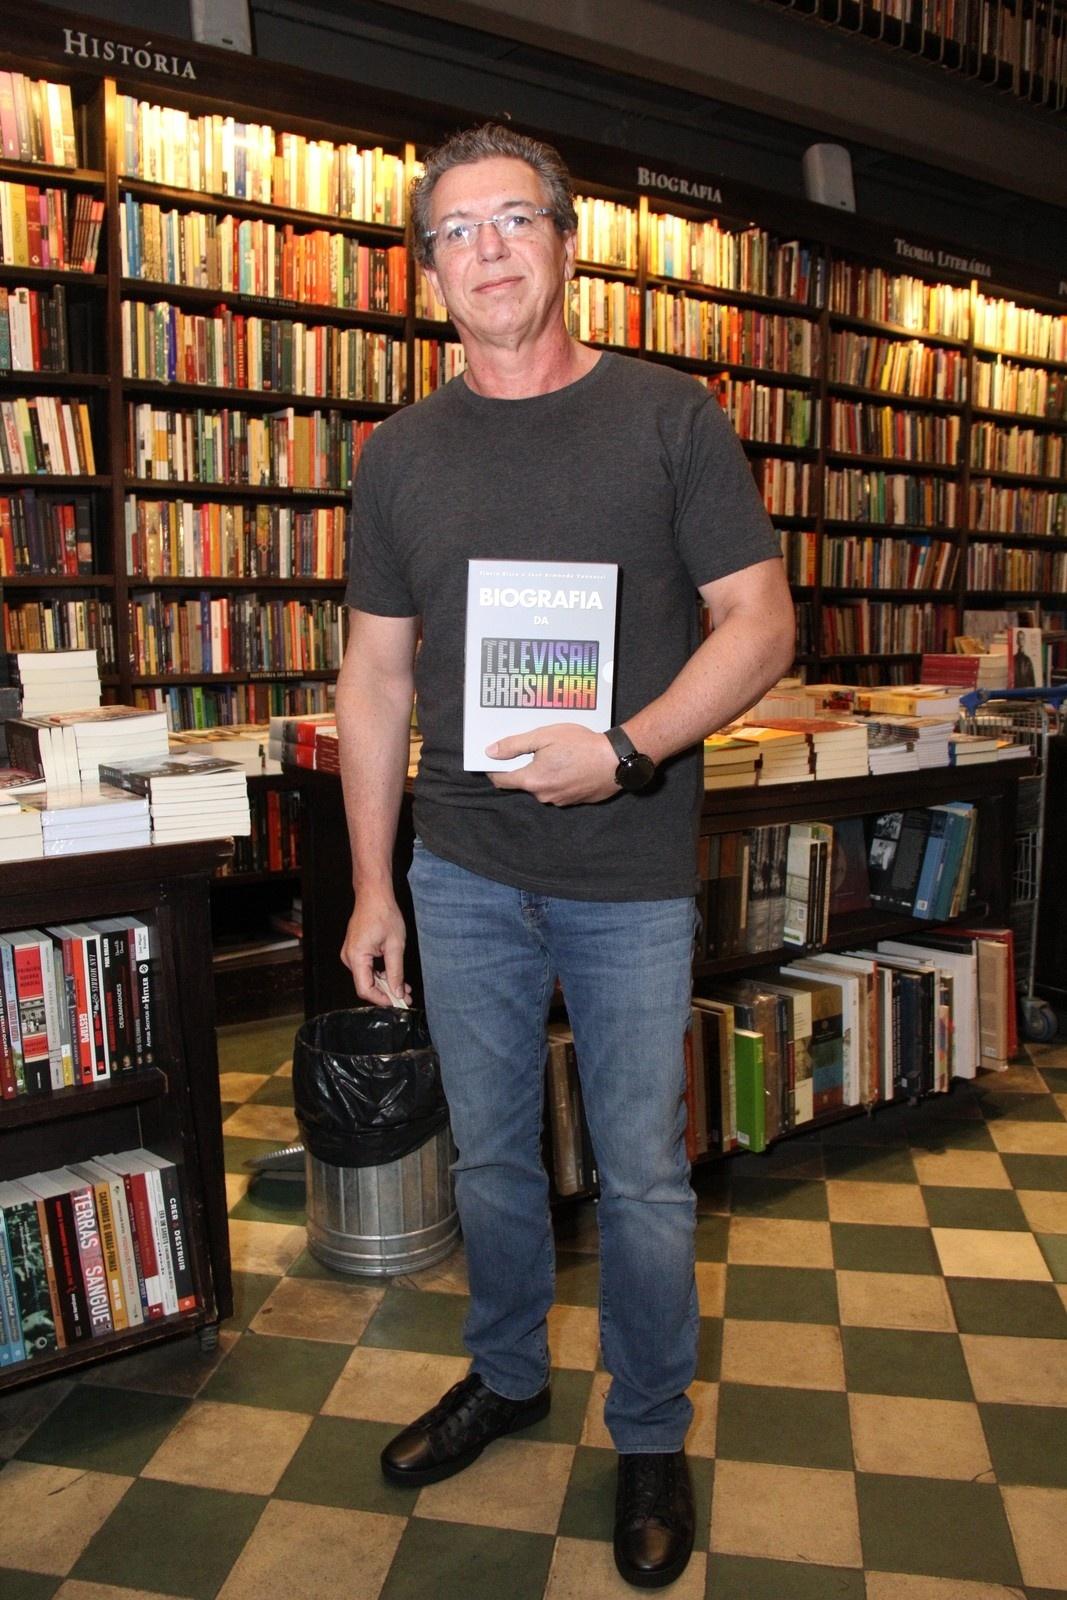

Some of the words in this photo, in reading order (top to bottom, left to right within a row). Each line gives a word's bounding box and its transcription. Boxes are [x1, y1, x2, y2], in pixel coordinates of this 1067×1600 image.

[63, 28, 197, 80] HISTÓRIA
[637, 166, 722, 204] BIOGRAFIA
[894, 237, 934, 263] TEORIA
[479, 587, 604, 610] BIOGRAFIA
[533, 615, 550, 625] DA
[482, 673, 597, 709] BRASILEIRA
[79, 1013, 90, 1043] GESTAPO
[73, 1191, 98, 1250] TERRAS
[169, 1198, 178, 1221] CRER
[174, 1229, 185, 1271] DESTRUIR
[85, 1265, 111, 1326] SANGUE
